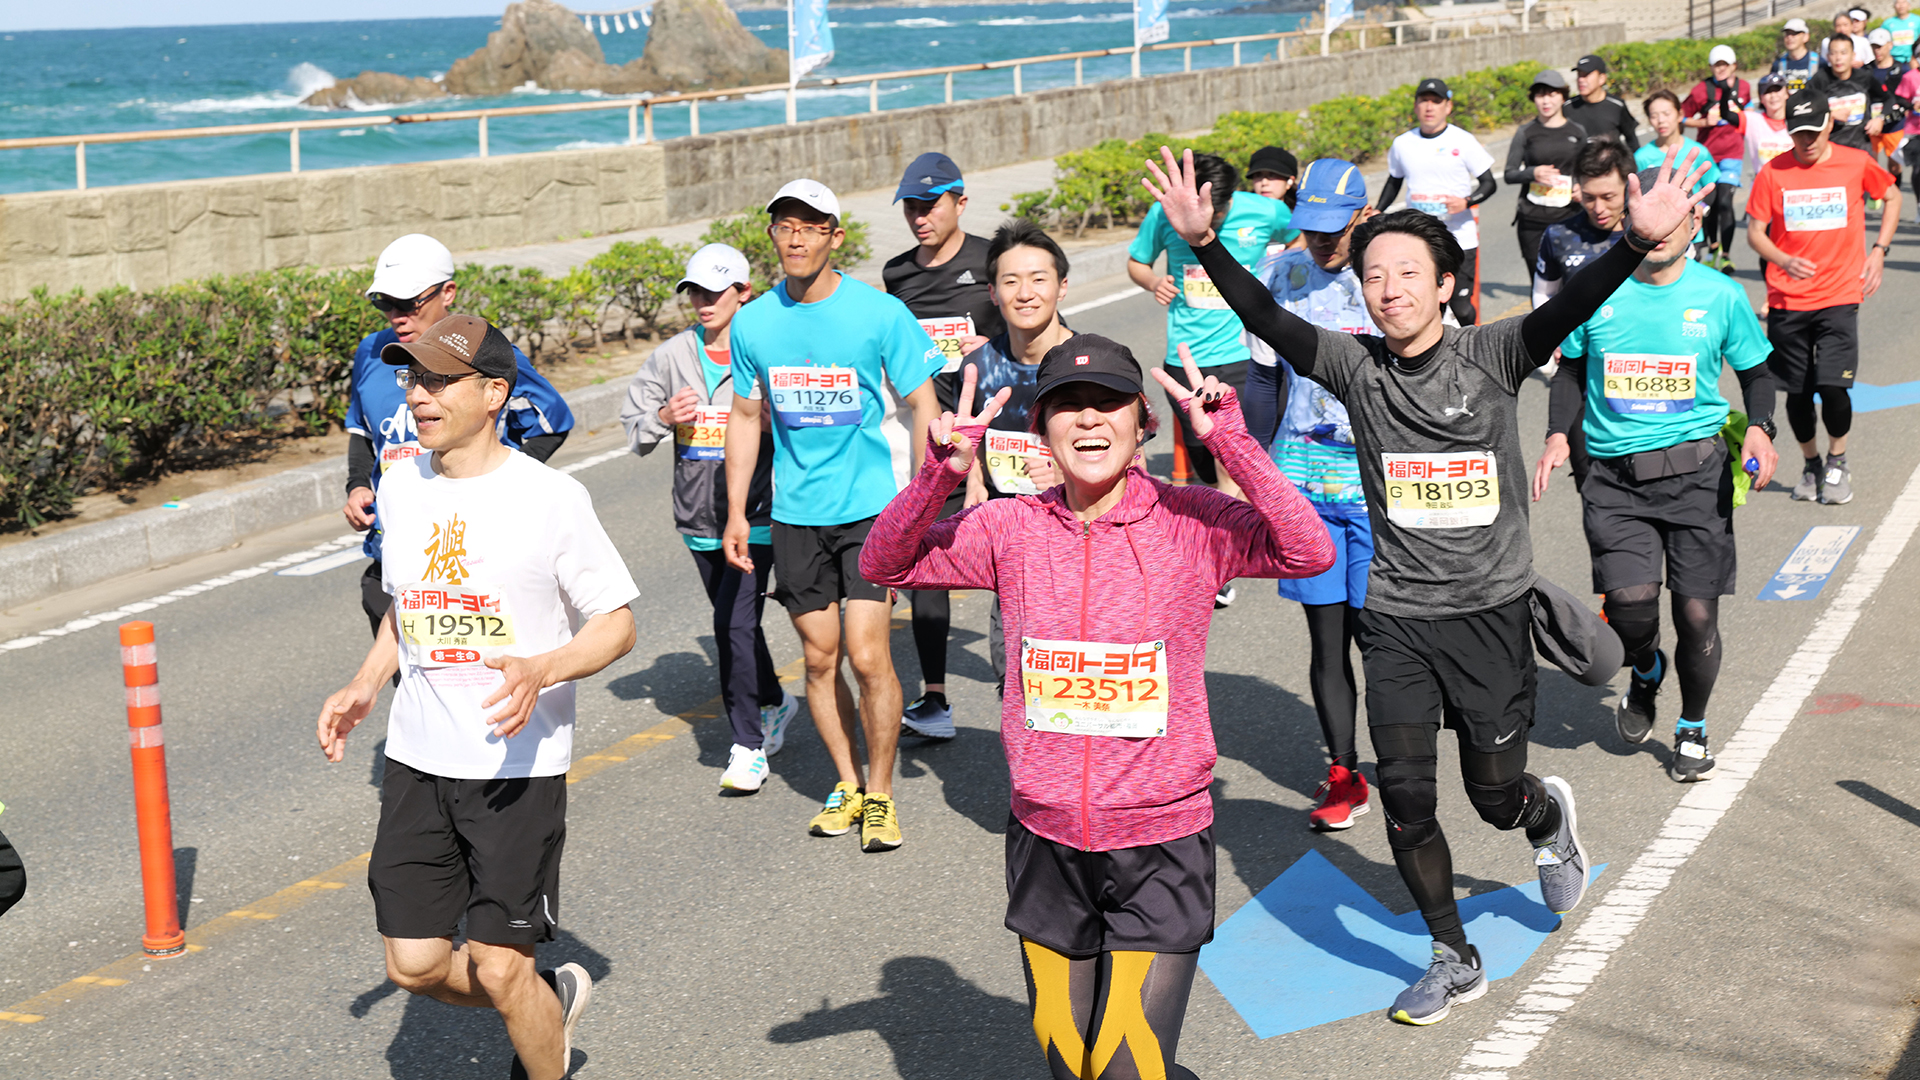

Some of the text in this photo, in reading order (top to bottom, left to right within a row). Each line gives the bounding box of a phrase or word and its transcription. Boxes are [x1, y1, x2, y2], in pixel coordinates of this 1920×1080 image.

[1799, 204, 1844, 216] 12649
[1200, 282, 1218, 293] 17
[1607, 360, 1691, 375] 福岡トヨタ
[773, 373, 851, 388] 福岡トヨタ
[1607, 377, 1691, 393] G 16883
[774, 390, 853, 406] D 11276
[688, 426, 727, 440] 234
[989, 457, 1001, 467] G
[1387, 459, 1489, 479] 福岡トヨタ
[1390, 480, 1491, 501] G 18193
[402, 614, 507, 637] H 19512
[434, 650, 476, 662] 第一生命
[1026, 647, 1157, 675] 福岡トヨタ
[1028, 677, 1160, 702] H 23512
